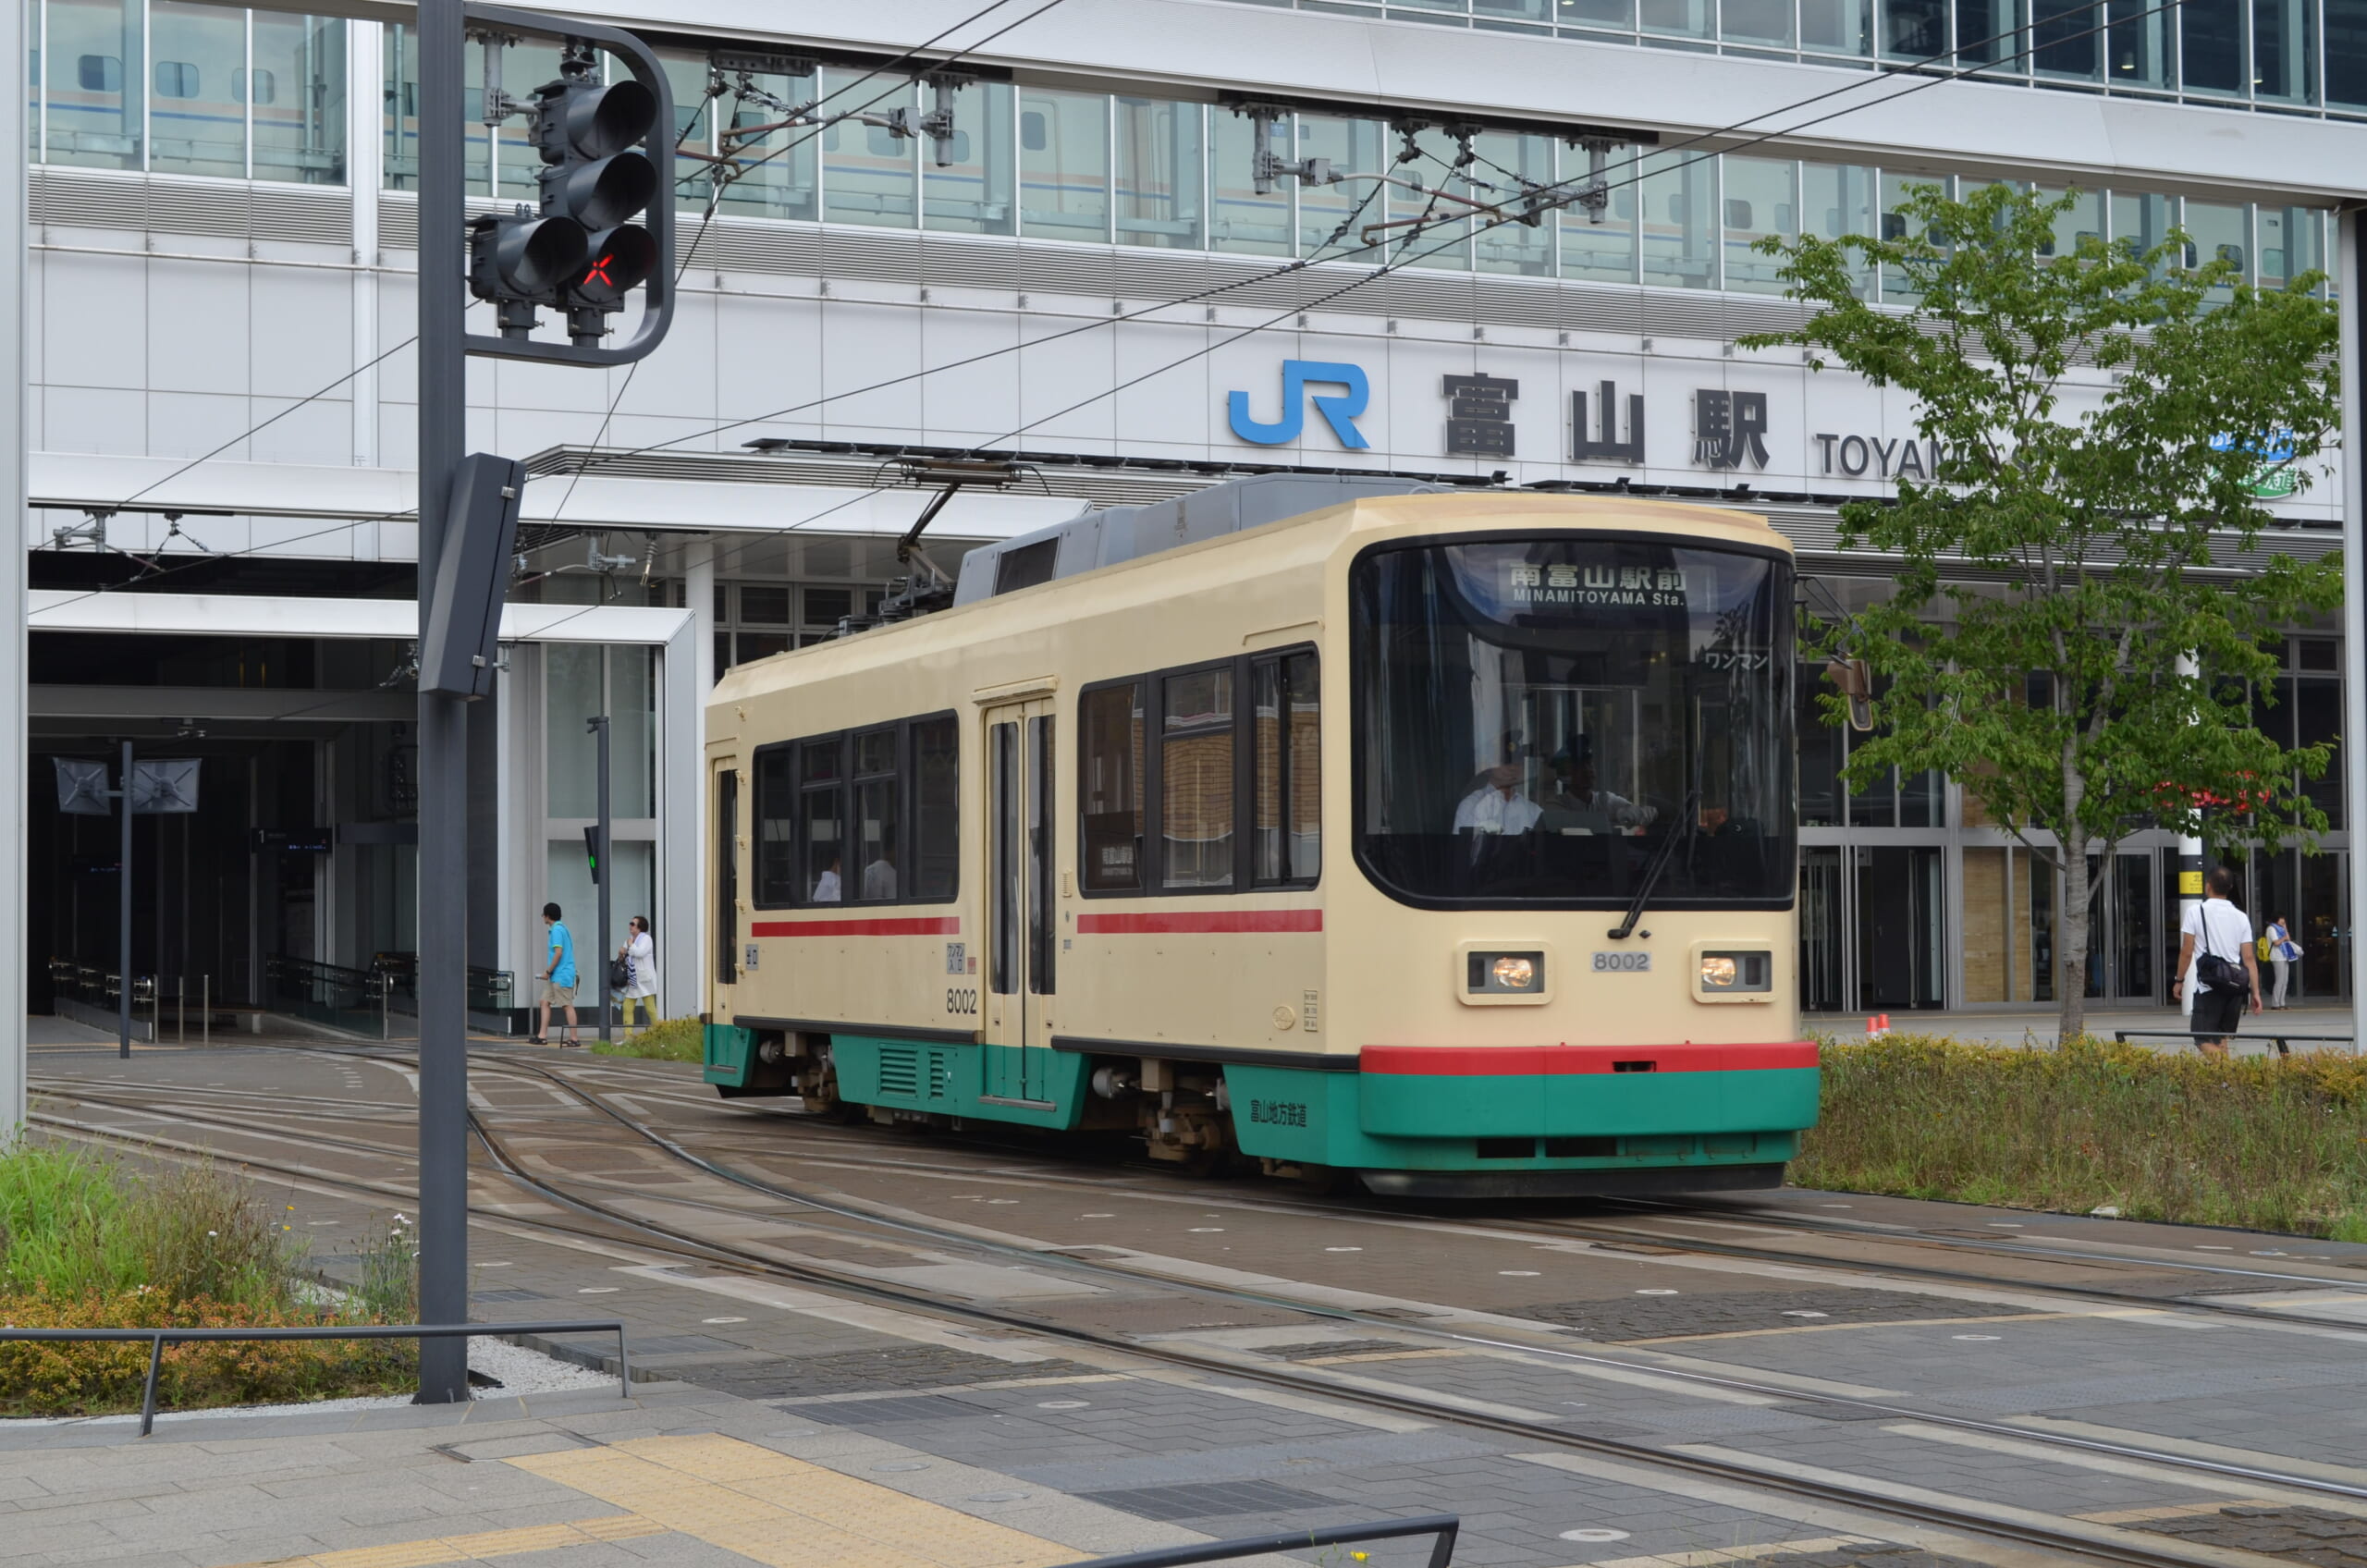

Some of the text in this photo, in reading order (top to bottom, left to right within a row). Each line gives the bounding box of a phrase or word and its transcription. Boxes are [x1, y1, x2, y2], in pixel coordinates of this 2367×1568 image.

[1228, 359, 1370, 449] JR
[1442, 372, 1771, 471] 富山駅
[1510, 562, 1687, 592] 南富山駅前
[1513, 588, 1686, 606] MINAMITOYAMA Sta.
[1704, 651, 1771, 670] ワンマン
[1593, 952, 1650, 971] 8002
[946, 987, 977, 1015] 8002
[1250, 1098, 1308, 1128] 富山地方鉄道
